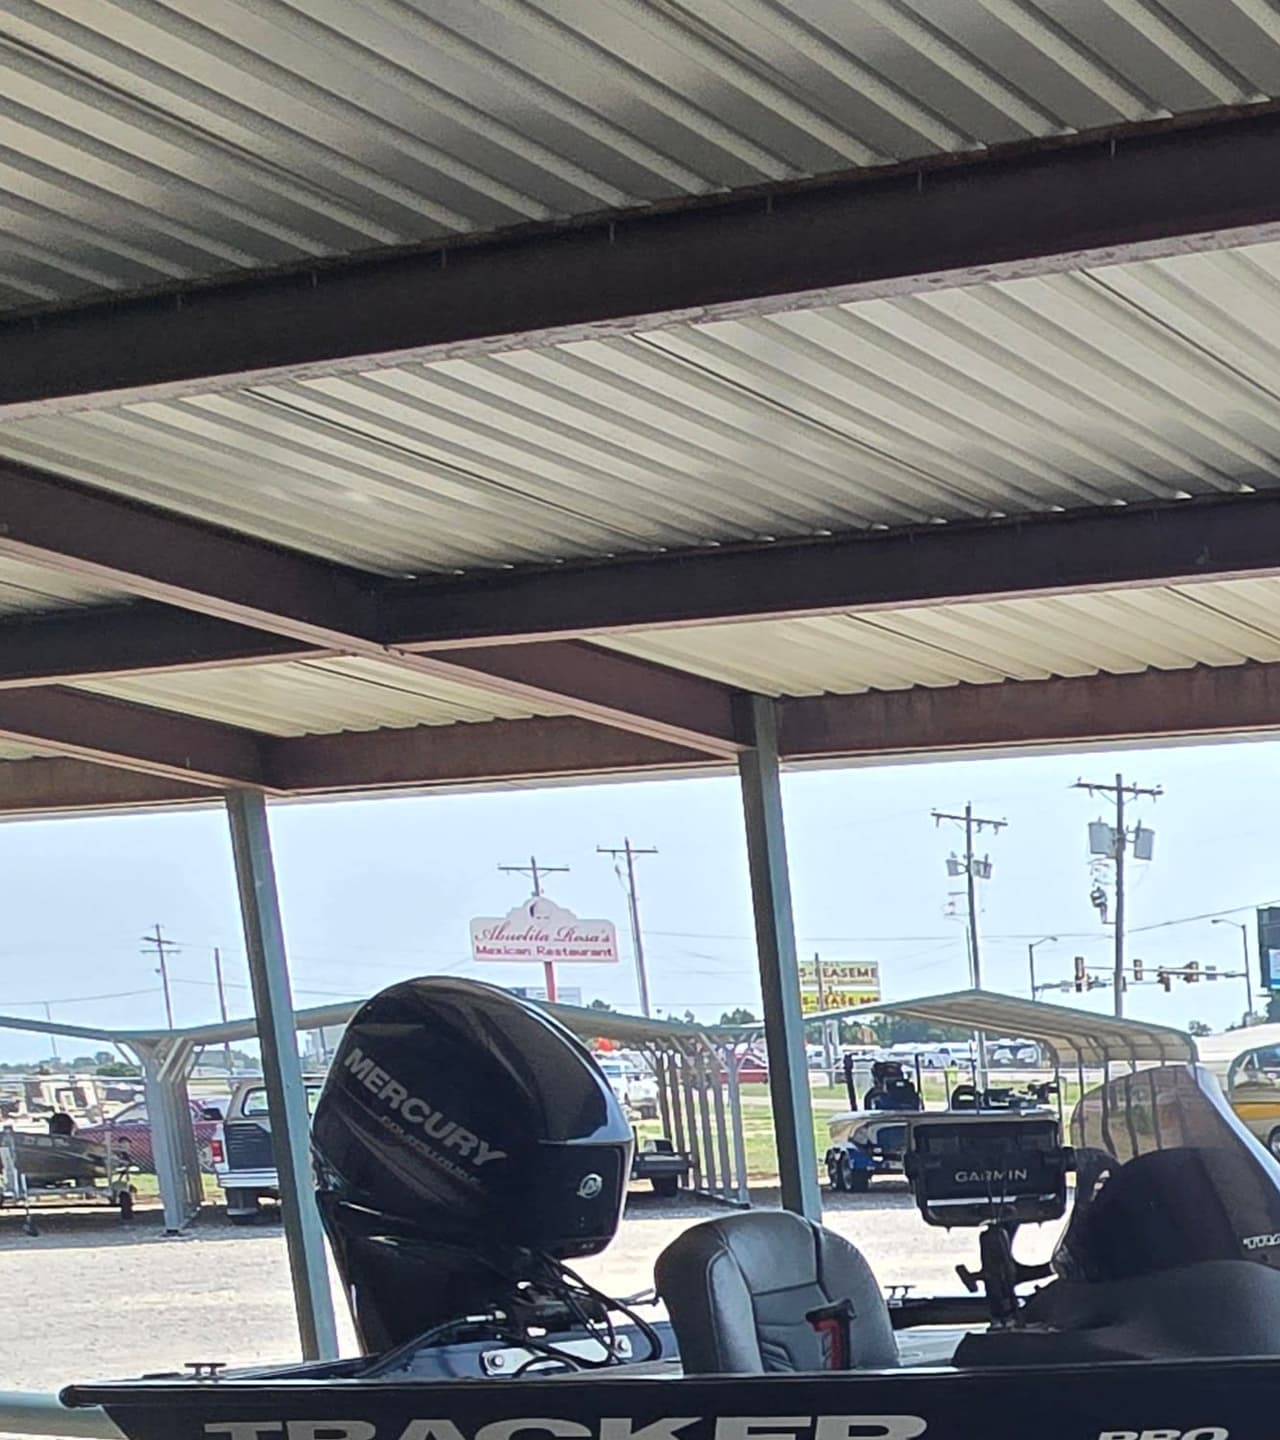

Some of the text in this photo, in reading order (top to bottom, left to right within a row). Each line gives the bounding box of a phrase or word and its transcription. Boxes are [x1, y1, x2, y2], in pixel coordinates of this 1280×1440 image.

[474, 920, 610, 943] Abuelita Rosa's
[475, 945, 612, 957] Mexican Restaurant
[344, 1048, 508, 1167] MERCURY
